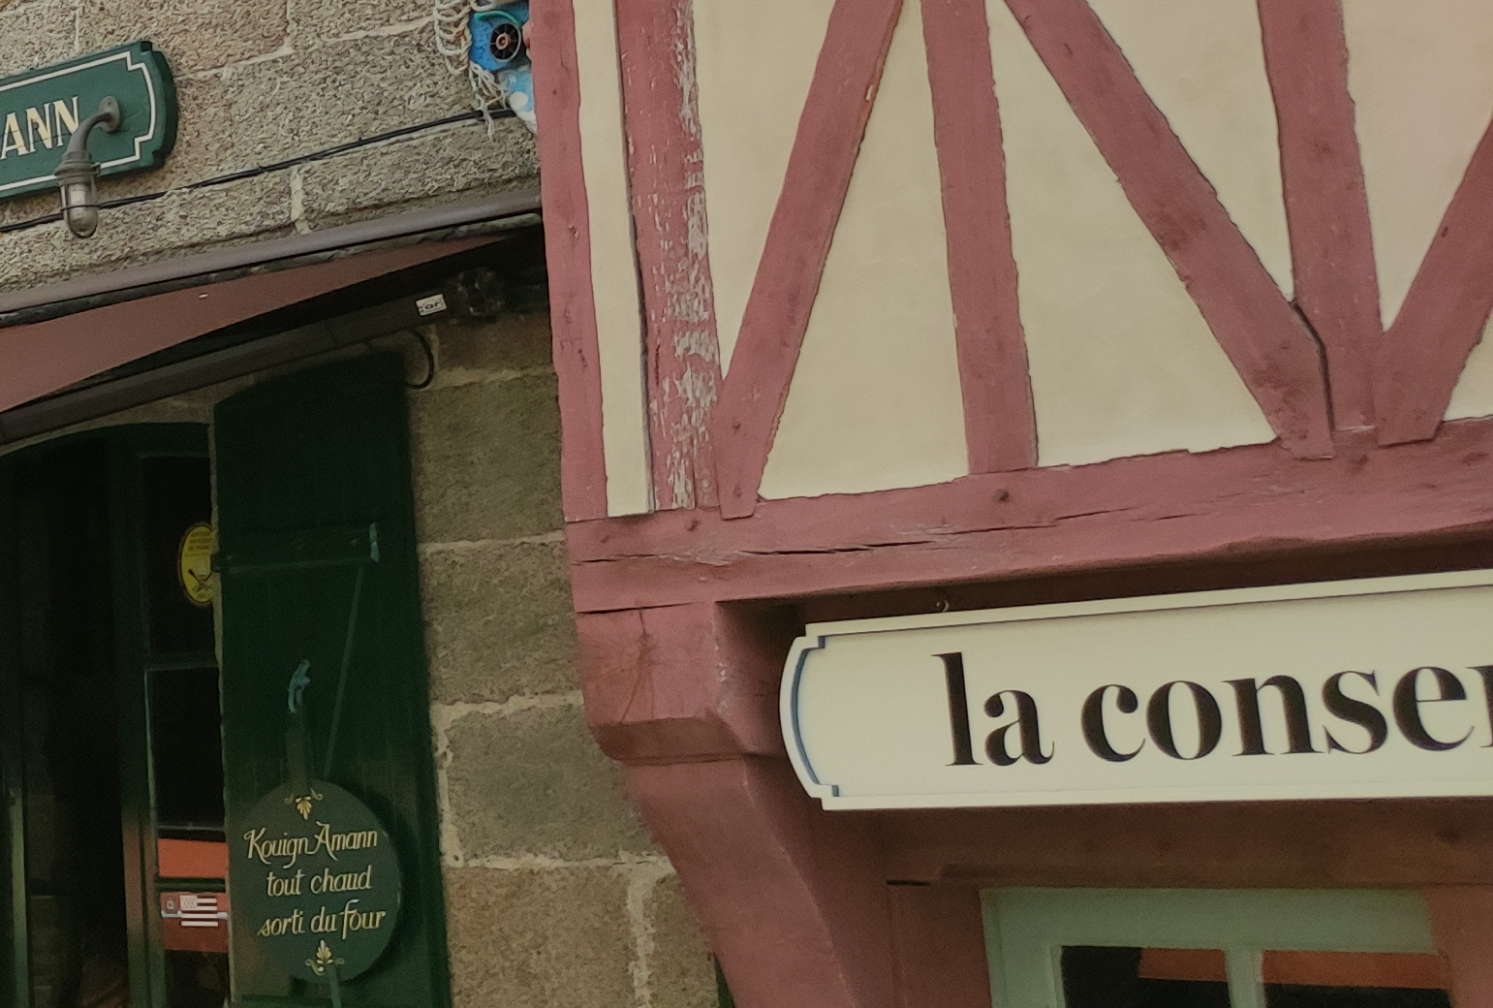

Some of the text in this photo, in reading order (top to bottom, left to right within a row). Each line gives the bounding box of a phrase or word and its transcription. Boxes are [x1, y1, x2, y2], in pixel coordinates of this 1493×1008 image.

[930, 651, 1055, 767] la
[243, 820, 378, 870] Kouign Amann
[266, 864, 372, 897] tout chaud
[256, 898, 387, 941] sorti du four
